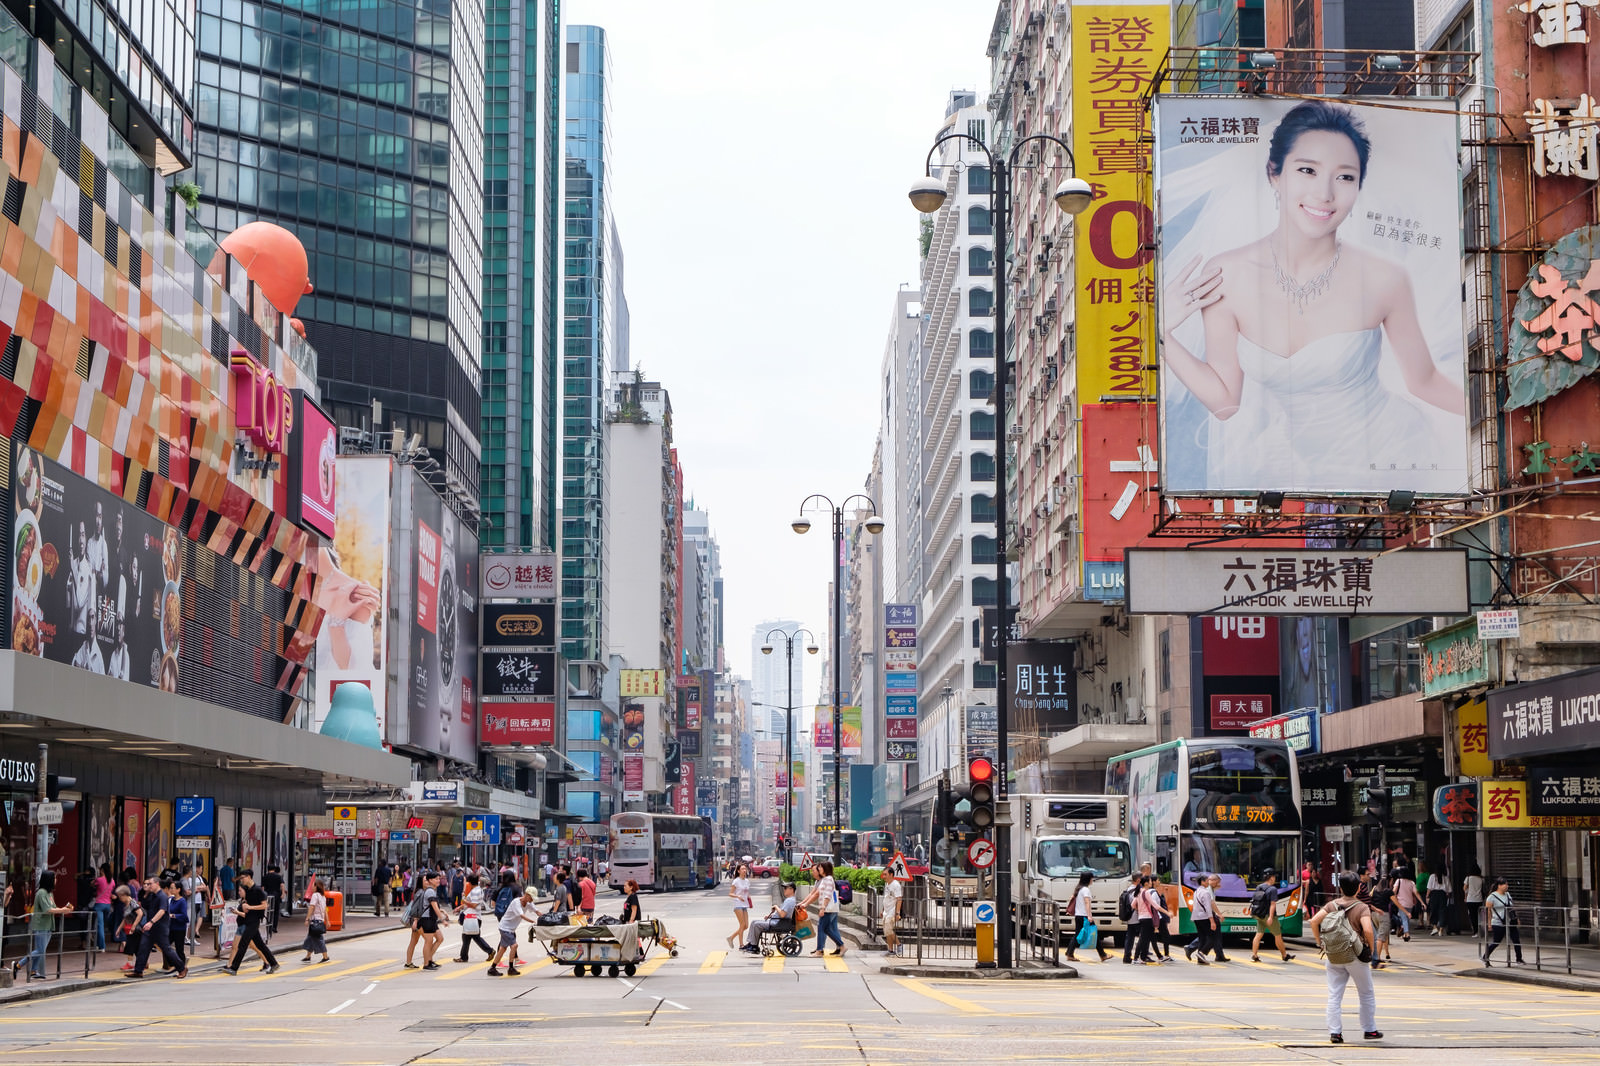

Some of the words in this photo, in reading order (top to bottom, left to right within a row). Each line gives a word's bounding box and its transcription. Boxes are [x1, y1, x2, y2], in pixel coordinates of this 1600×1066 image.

[1086, 16, 1154, 176] 證券買賣
[1180, 117, 1259, 136] 六福珠寶
[1180, 136, 1214, 144] LUKFOOK
[1216, 136, 1259, 144] JEWELLERY
[1374, 223, 1442, 250] 因為愛很美
[1085, 276, 1154, 304] 佣金
[231, 351, 293, 450] TOP
[1223, 556, 1374, 592] 六福珠寶
[1224, 595, 1286, 607] LUKFOOK
[1293, 595, 1374, 607] JEWELLERY
[1016, 665, 1068, 696] 周生生
[1219, 700, 1264, 713] 周大福
[1503, 696, 1553, 741] 六福珠寶
[0, 759, 36, 783] GUESS
[180, 805, 195, 813] 巴士
[1542, 796, 1577, 804] LUKFOOK
